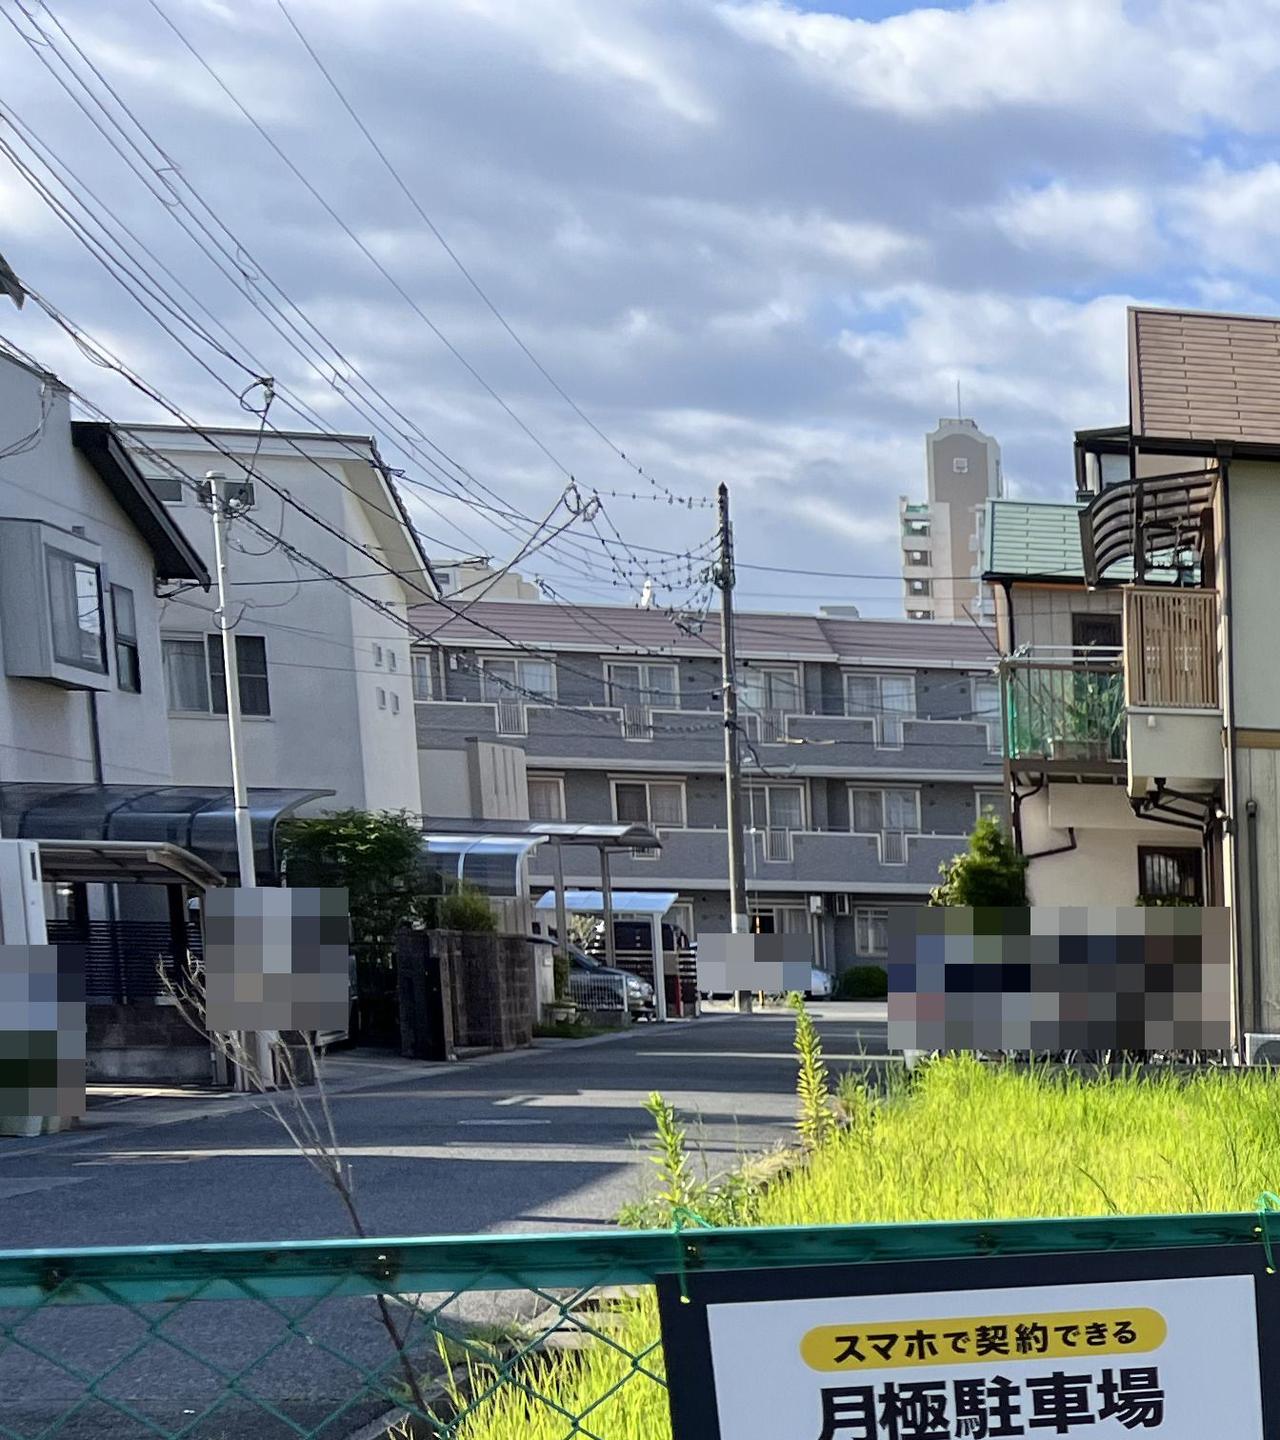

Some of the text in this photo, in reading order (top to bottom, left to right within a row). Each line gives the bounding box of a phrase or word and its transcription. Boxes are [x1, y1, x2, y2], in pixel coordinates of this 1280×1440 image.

[834, 1319, 1137, 1363] スマホで契約できる
